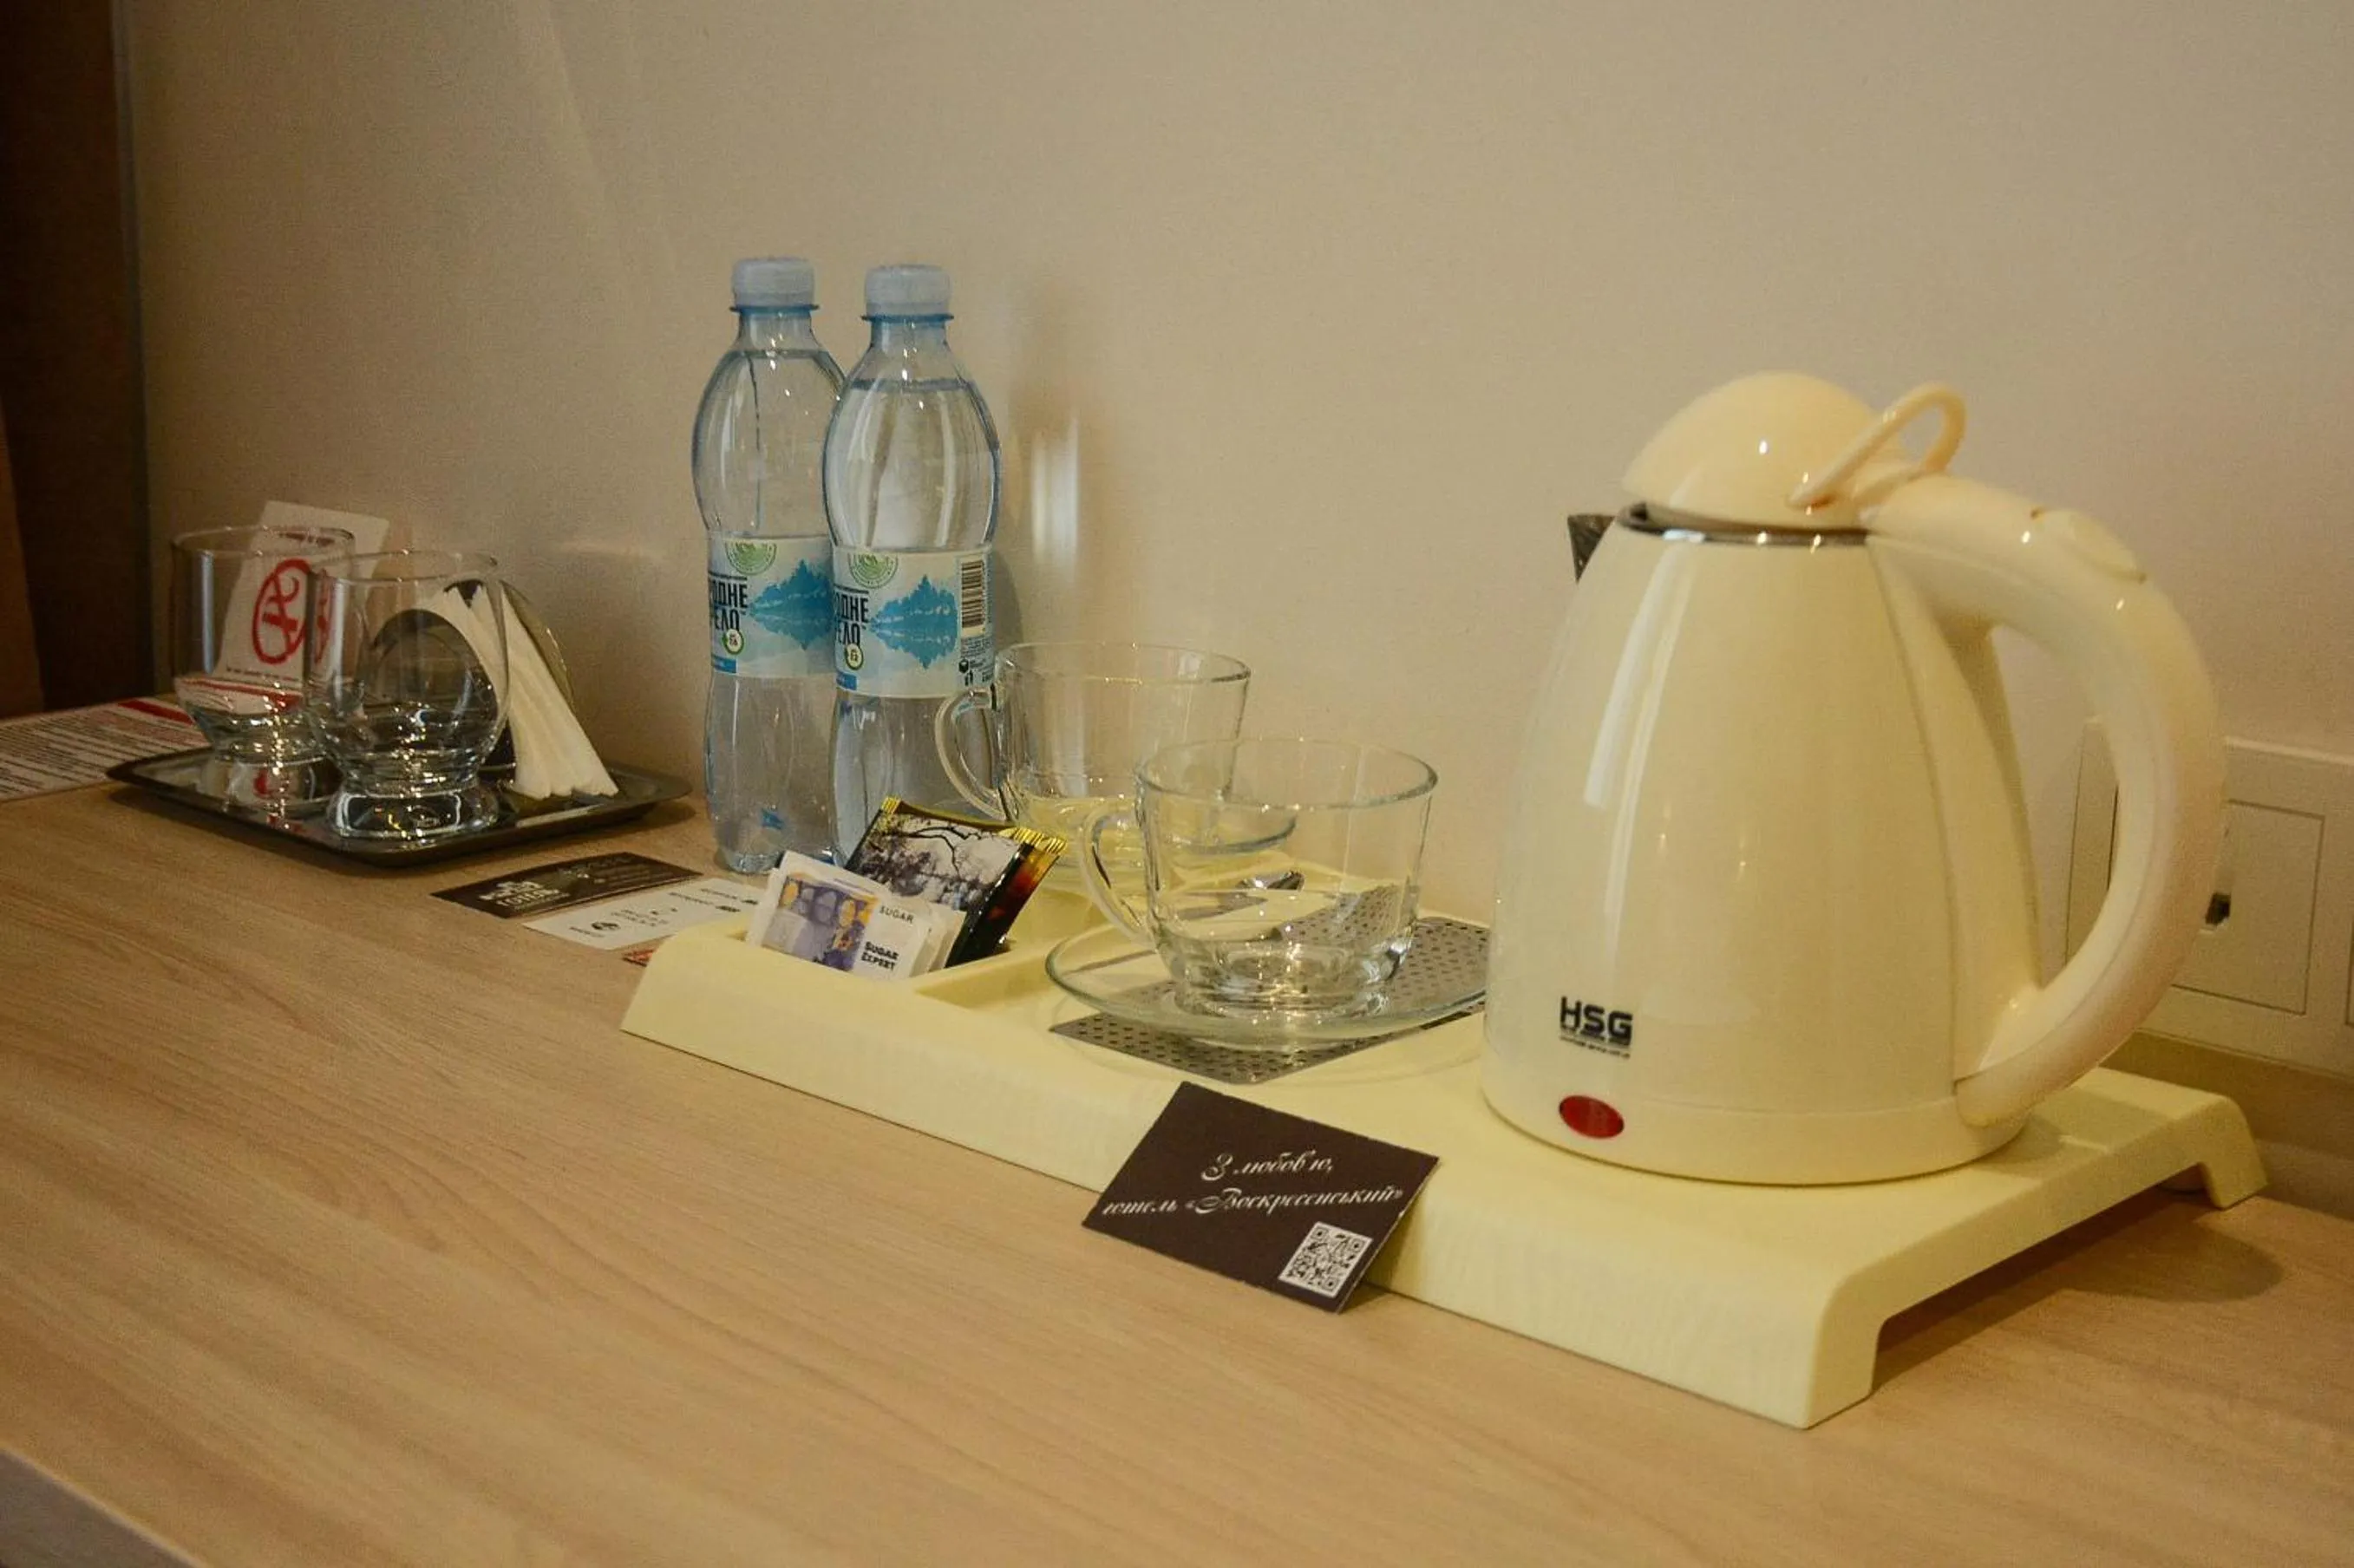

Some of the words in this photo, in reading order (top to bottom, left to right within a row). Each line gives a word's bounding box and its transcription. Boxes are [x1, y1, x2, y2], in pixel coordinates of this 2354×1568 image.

[879, 905, 914, 924] SUGAR
[866, 941, 899, 960] SUGAR
[1560, 996, 1633, 1042] HSG
